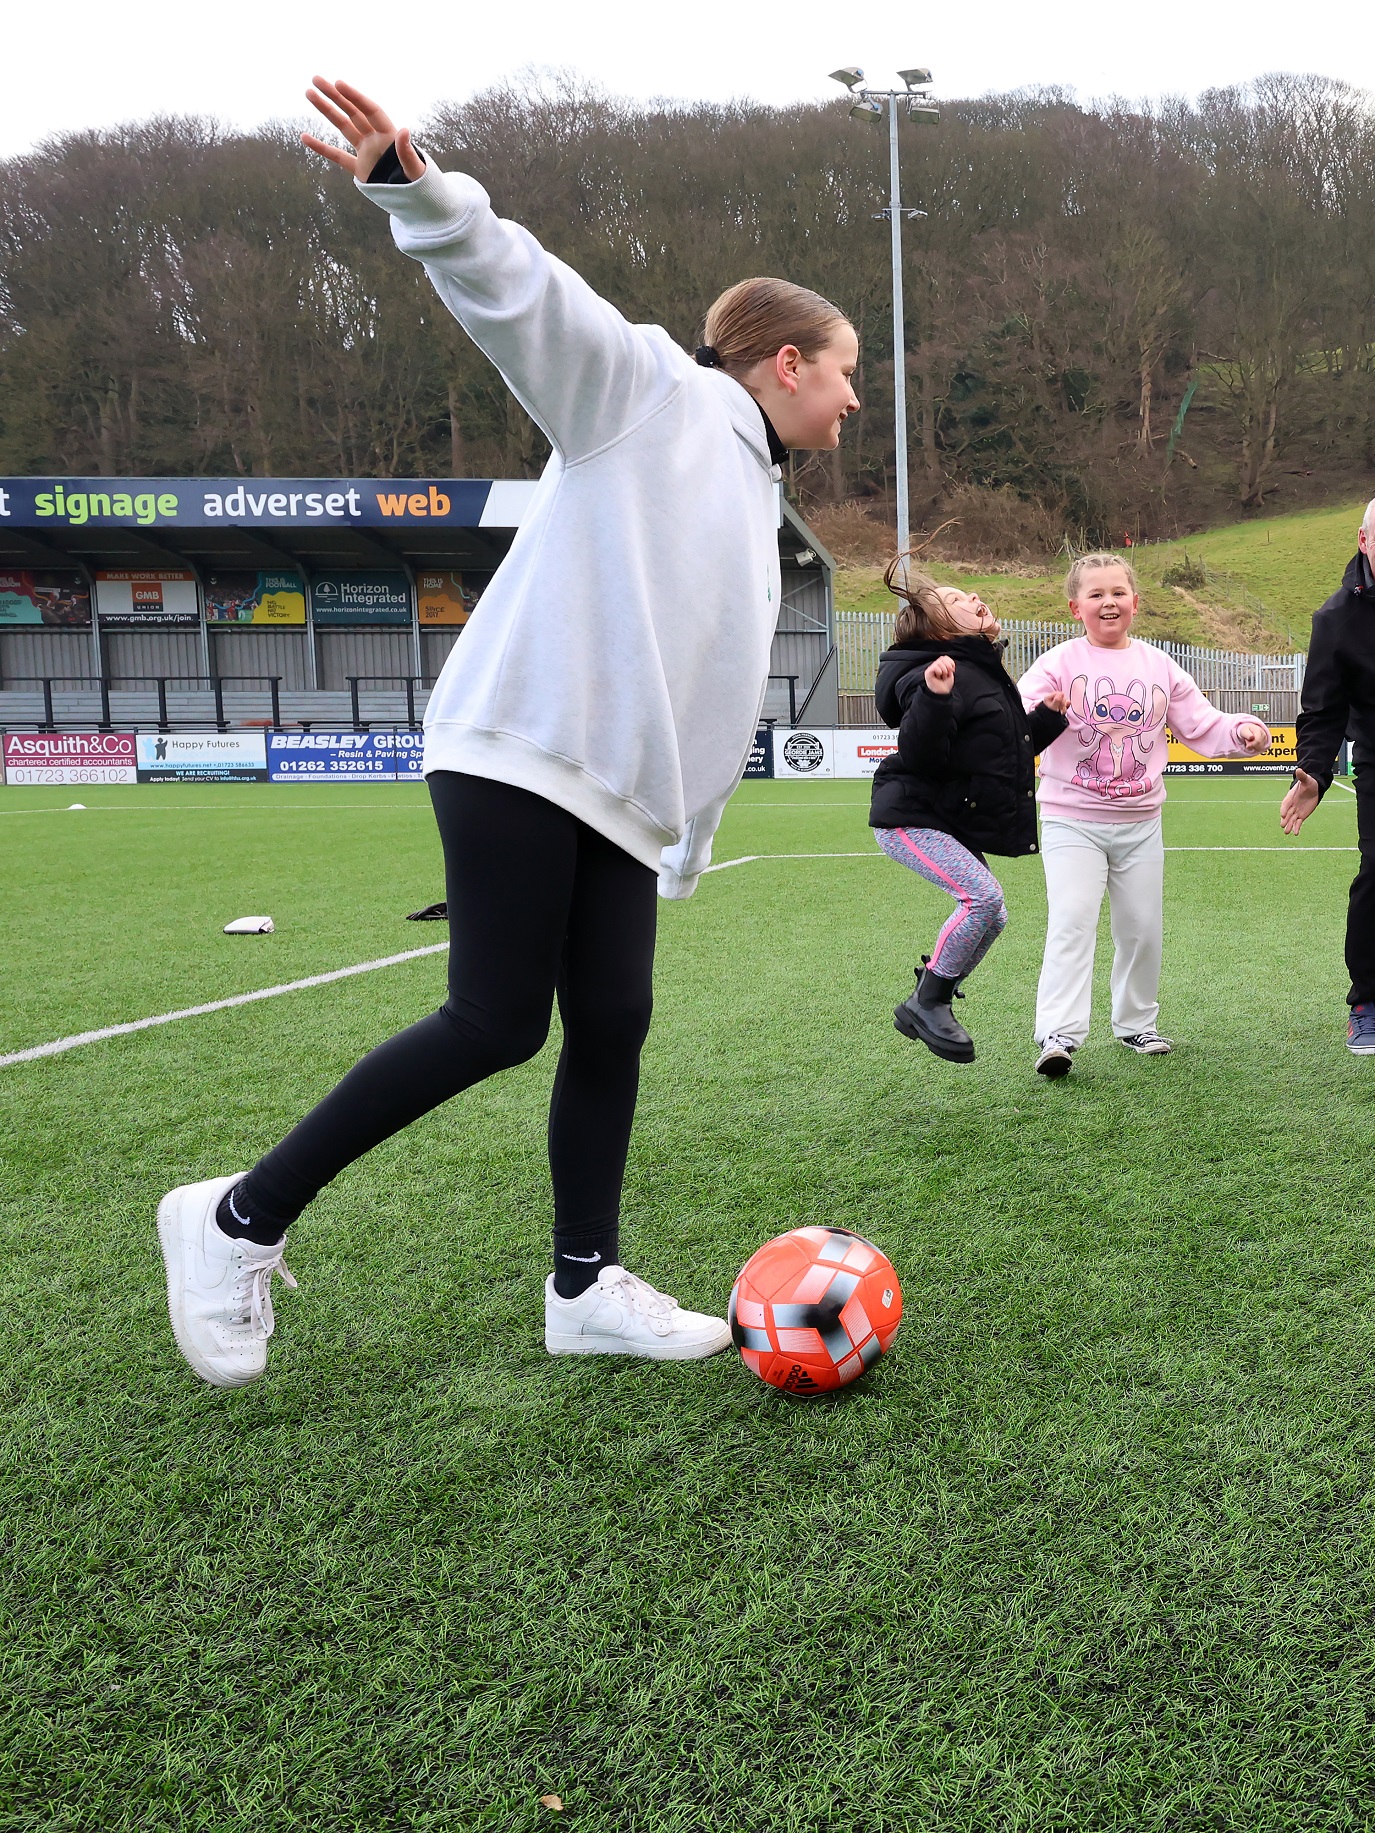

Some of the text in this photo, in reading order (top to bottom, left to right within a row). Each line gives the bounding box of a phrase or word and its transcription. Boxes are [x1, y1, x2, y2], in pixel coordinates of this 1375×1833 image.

[35, 485, 178, 524] signage
[203, 486, 361, 517] adverset
[376, 486, 452, 517] web
[341, 583, 389, 593] Horizon
[136, 592, 160, 600] GMB
[341, 593, 406, 605] Integrated
[106, 614, 192, 622] www.gmb.org.uk/join
[8, 736, 132, 756] Asquith&Co
[172, 741, 203, 749] Happy
[271, 736, 369, 749] BEASLEY
[375, 750, 407, 759] Paving
[280, 761, 325, 771] 01262
[330, 761, 383, 771] 352615
[15, 770, 64, 782] 01723
[70, 769, 127, 782] 366102
